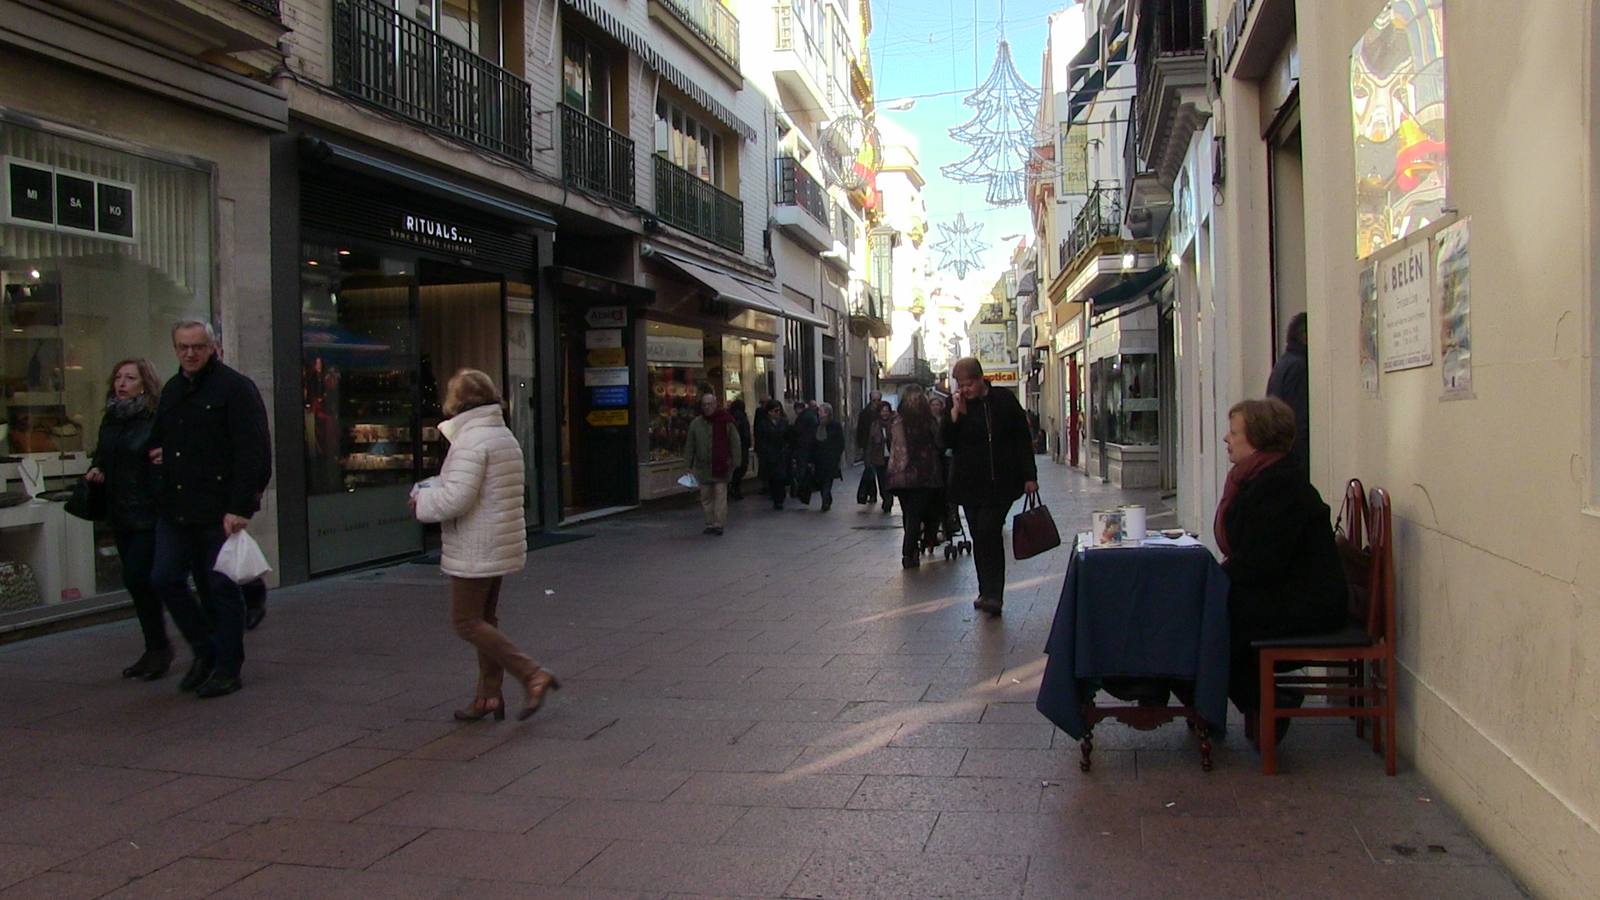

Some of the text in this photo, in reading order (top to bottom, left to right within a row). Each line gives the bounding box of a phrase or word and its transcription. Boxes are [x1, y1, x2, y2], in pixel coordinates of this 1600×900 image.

[27, 188, 121, 216] MI SA KO
[406, 215, 473, 244] RITUALS...
[1391, 249, 1424, 290] BELÉN
